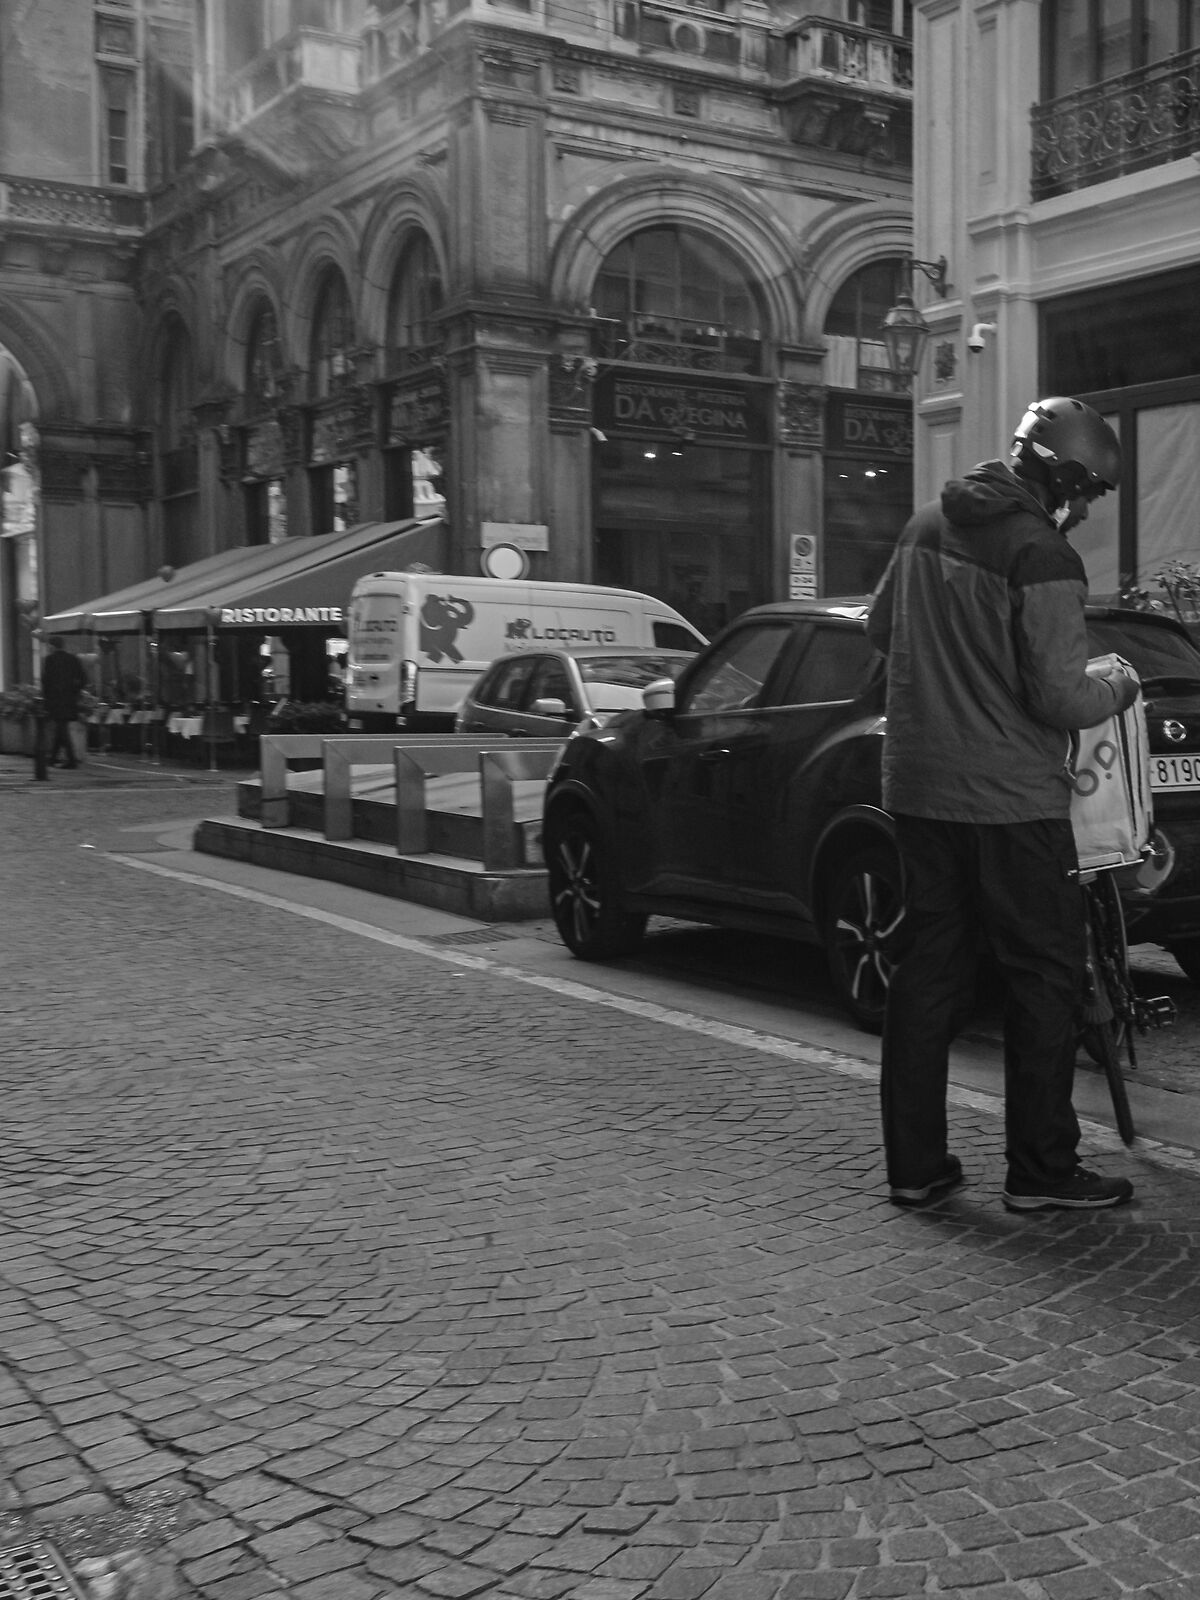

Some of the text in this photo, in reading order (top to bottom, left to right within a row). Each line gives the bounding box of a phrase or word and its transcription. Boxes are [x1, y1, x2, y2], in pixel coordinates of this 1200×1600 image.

[614, 394, 656, 421] DA
[844, 418, 880, 442] DA
[221, 607, 343, 623] RISTORANTE
[532, 627, 616, 643] LOCAUTO
